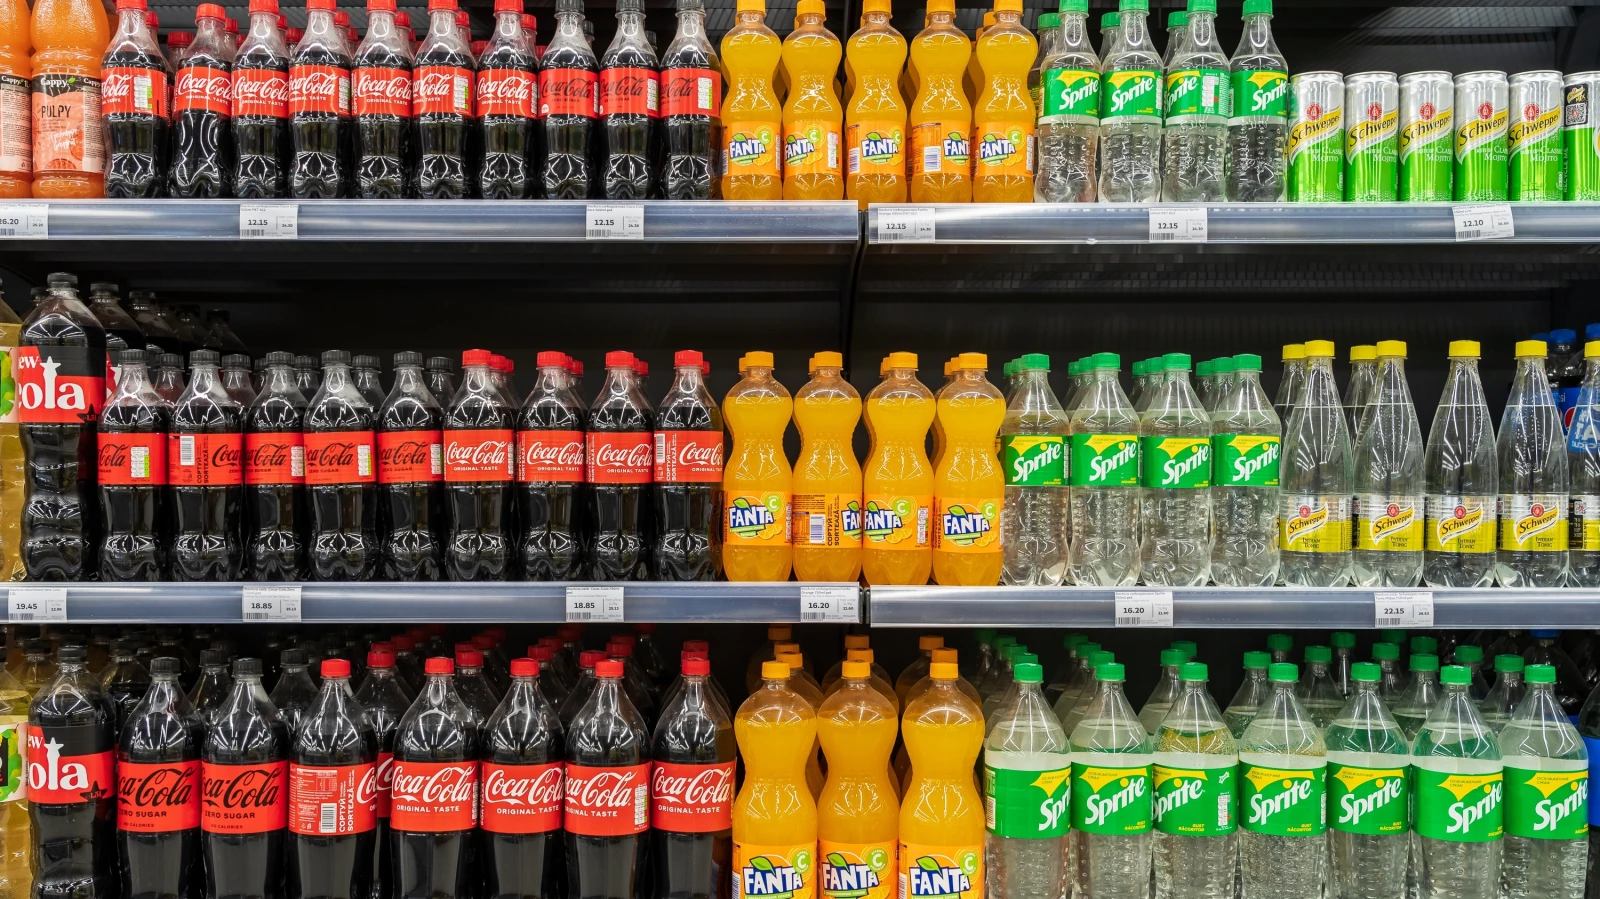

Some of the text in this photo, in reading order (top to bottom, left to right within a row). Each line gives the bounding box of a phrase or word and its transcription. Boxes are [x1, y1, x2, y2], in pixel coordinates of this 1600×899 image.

[1, 75, 21, 84] Cappy
[41, 78, 68, 88] Cappy
[234, 76, 289, 101] Coca-Cola
[358, 74, 411, 100] Coca-Cola
[477, 76, 532, 100] Coca-Cola
[542, 78, 592, 98] Coca-Cola
[1059, 78, 1099, 110] Sprite
[1111, 77, 1154, 112] Sprite
[42, 105, 72, 118] PULPY
[1509, 115, 1559, 148] Schweppes
[730, 139, 766, 158] FANTA
[785, 140, 814, 160] FANTA
[862, 139, 898, 157] FANTA
[944, 140, 970, 156] FANT
[980, 140, 1016, 158] FANTA
[19, 356, 39, 368] ew
[19, 364, 86, 410] ola
[447, 440, 507, 465] Coca-Cola
[527, 442, 585, 465] Coca-Cola
[596, 443, 653, 467] Coca-Cola
[1012, 443, 1061, 482] Sprite
[1089, 442, 1136, 482] Sprite
[1232, 444, 1279, 482] Sprite
[1162, 445, 1209, 485] Sprite
[770, 499, 777, 509] C
[898, 502, 905, 512] C
[986, 506, 993, 516] C
[730, 506, 774, 527] FANTA
[864, 510, 902, 530] FANTA
[944, 514, 990, 534] FANTA
[1289, 512, 1326, 534] Schweppes
[1375, 512, 1412, 533] Schweppes
[1442, 513, 1481, 535] Schweppes
[1519, 512, 1558, 534] Schweppes
[29, 745, 89, 790] ola
[392, 766, 475, 802] Coca-Cola
[652, 767, 732, 804] Coca-Cola
[539, 805, 559, 813] TASTE
[658, 805, 693, 813] ORIGINAL
[1085, 777, 1146, 826] Sprite
[1249, 780, 1311, 825] Sprite
[1339, 778, 1401, 825] Sprite
[1447, 782, 1502, 834] Sprite
[1534, 779, 1588, 831] Sprite
[798, 855, 806, 868] C
[872, 854, 882, 867] C
[964, 856, 973, 870] C
[743, 866, 803, 894] FANTA
[822, 864, 879, 890] FANTA
[910, 868, 970, 895] FANTA
